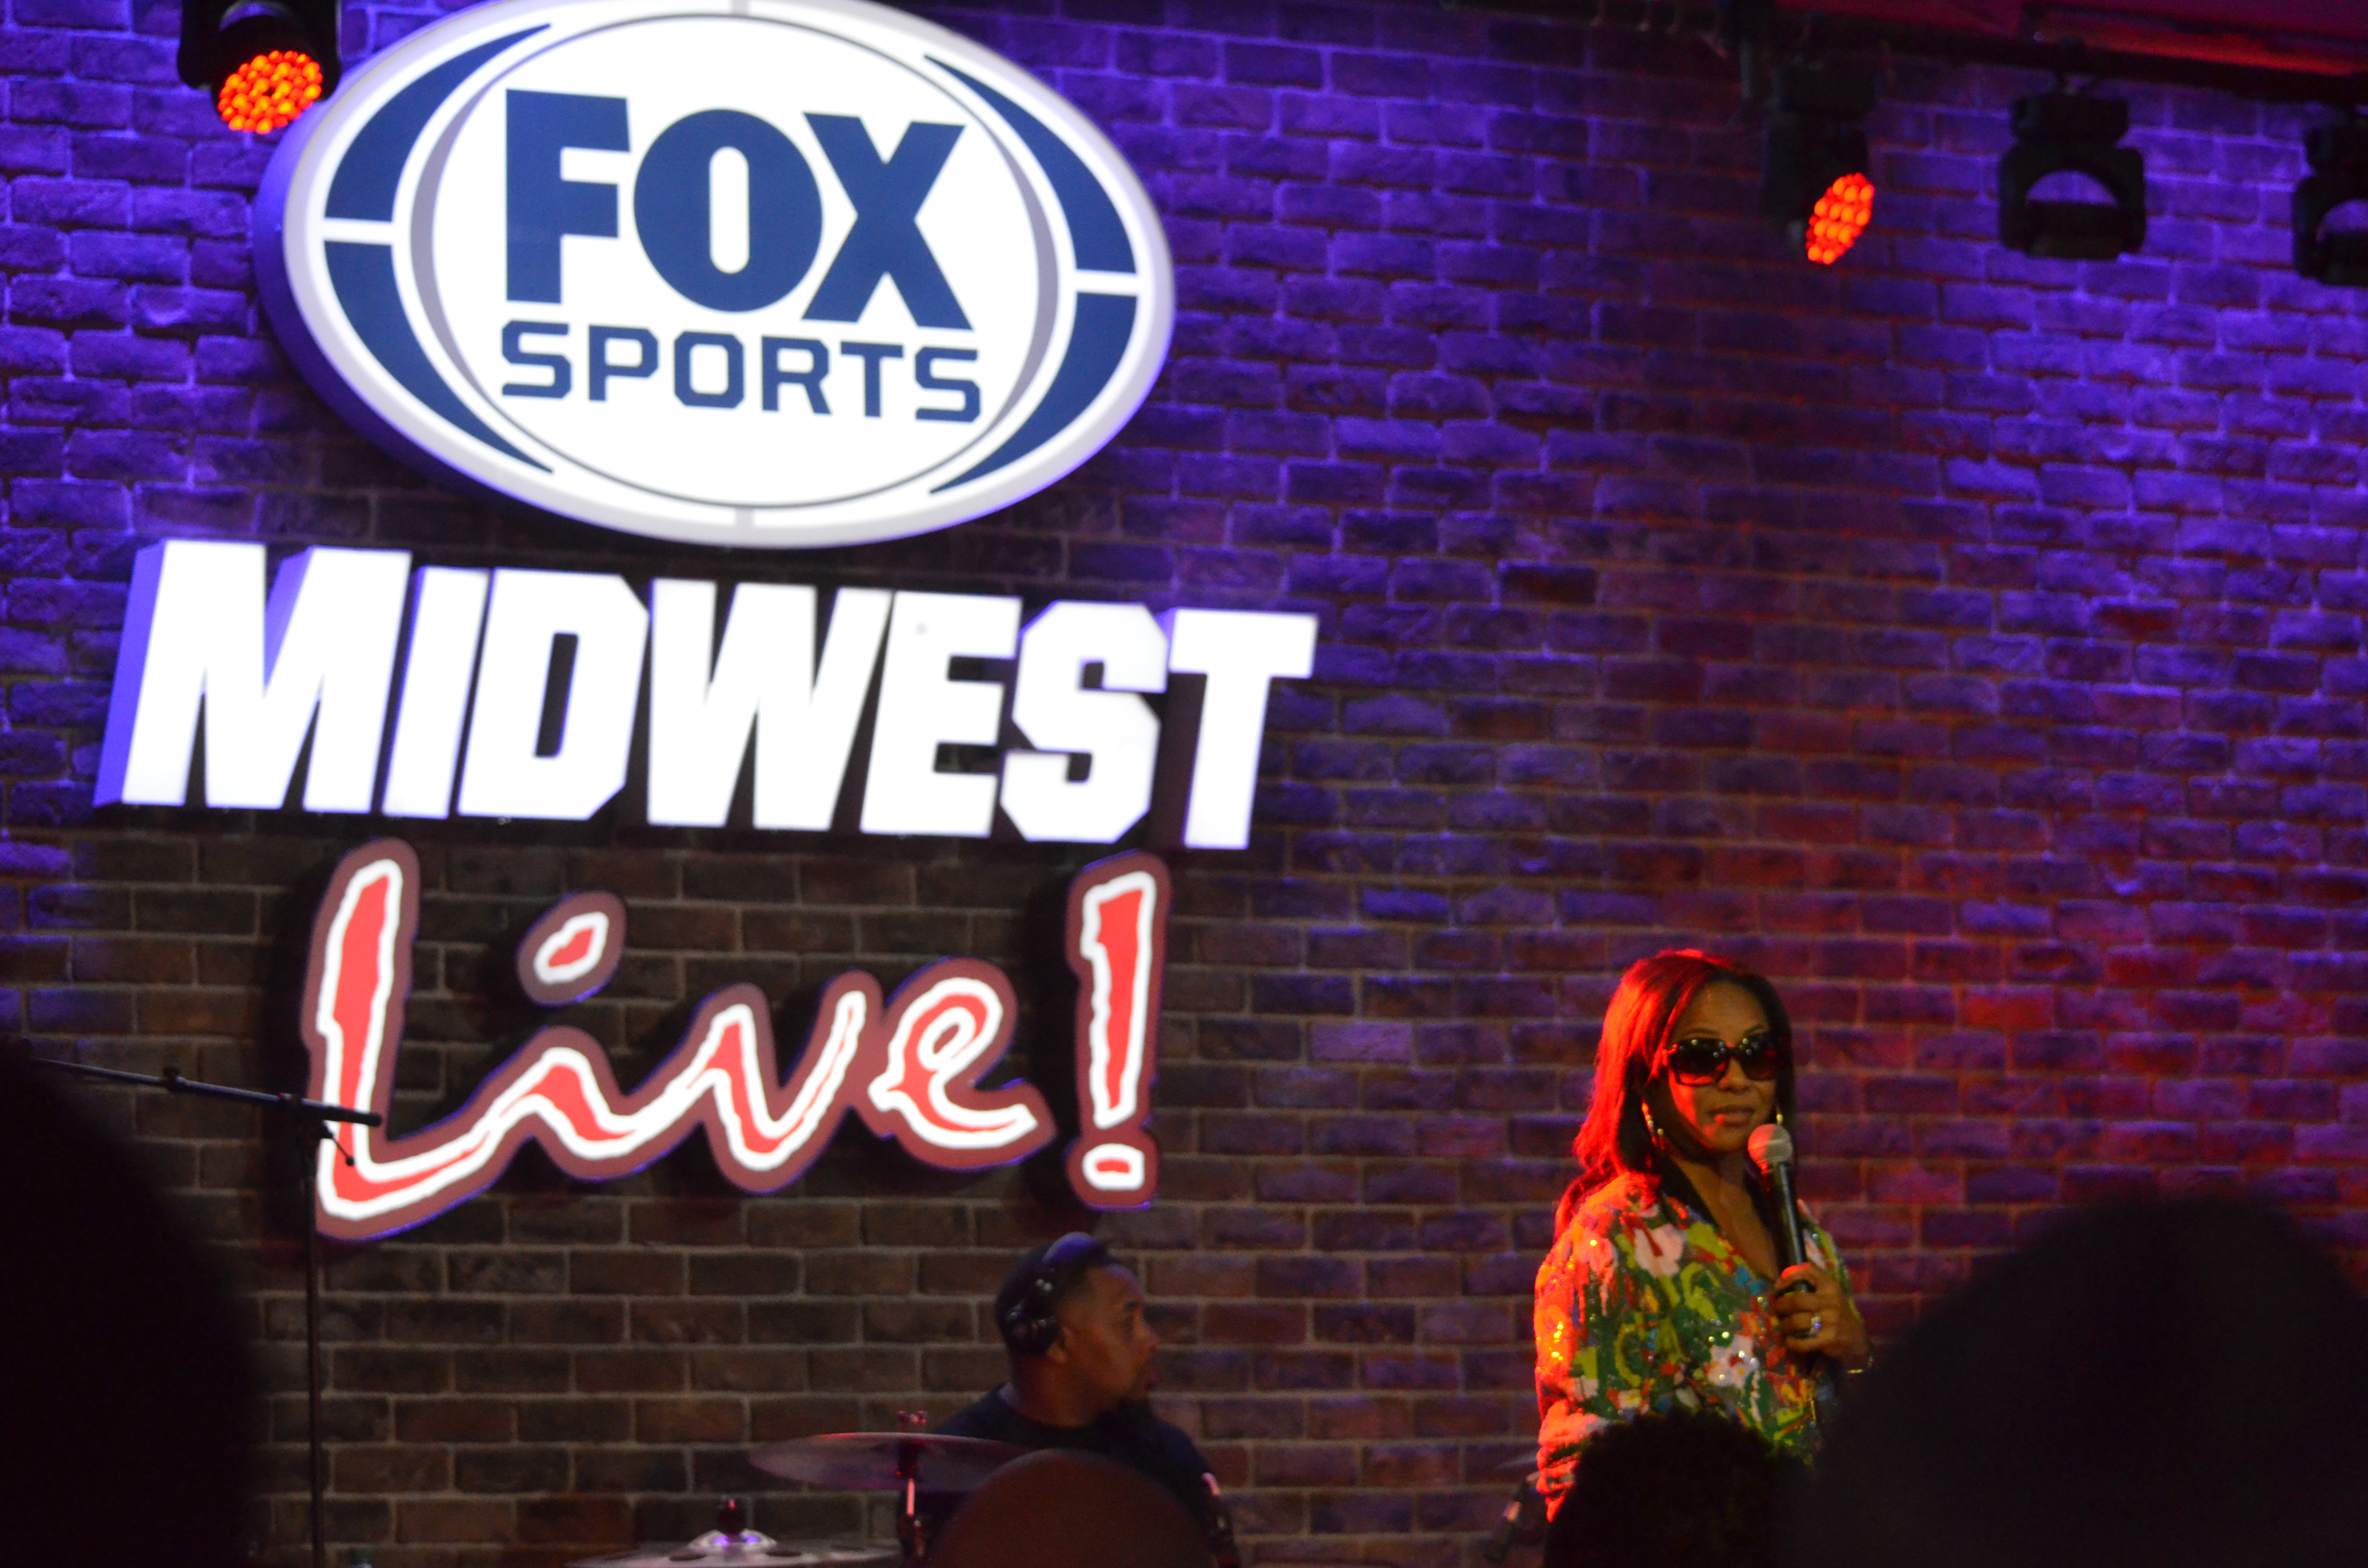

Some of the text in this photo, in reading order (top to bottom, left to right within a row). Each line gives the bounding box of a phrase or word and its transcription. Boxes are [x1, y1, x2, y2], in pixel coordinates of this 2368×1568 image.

[505, 88, 974, 331] FOX
[501, 319, 981, 423] SPORTS
[118, 539, 1320, 850] MIDWEST
[303, 839, 1171, 1240] Live!
